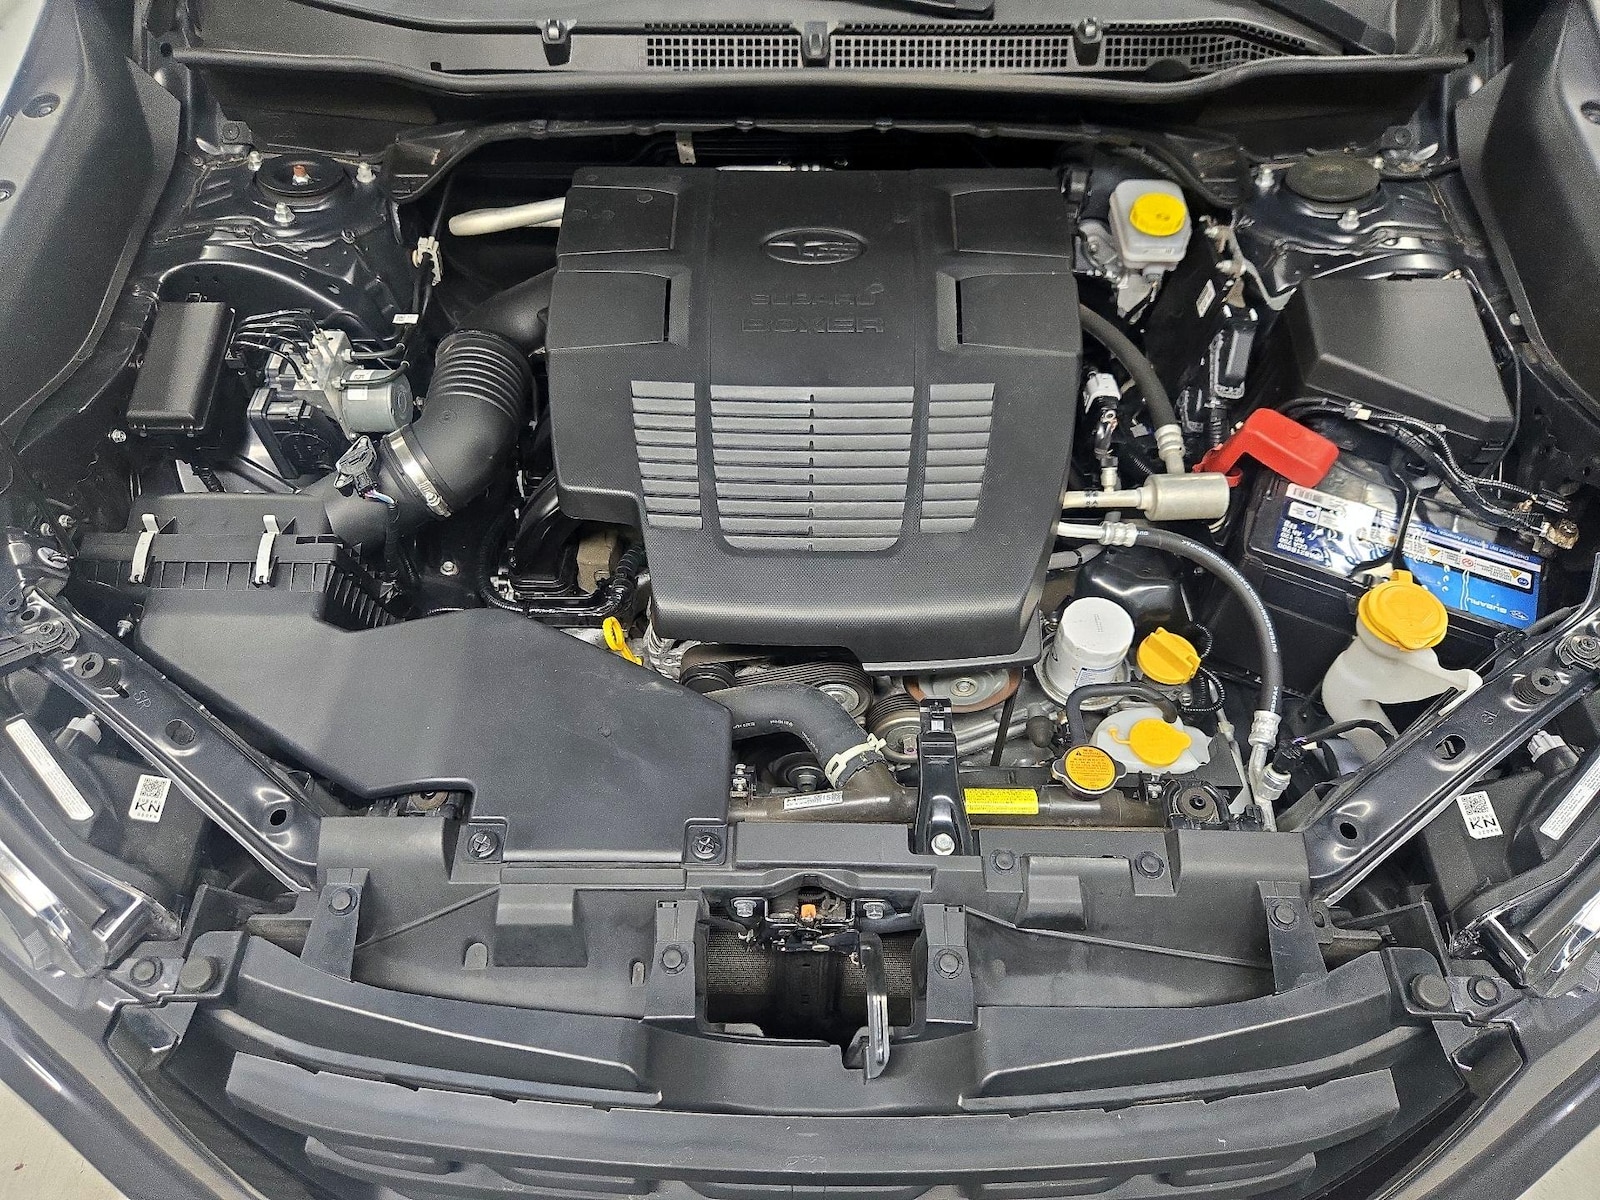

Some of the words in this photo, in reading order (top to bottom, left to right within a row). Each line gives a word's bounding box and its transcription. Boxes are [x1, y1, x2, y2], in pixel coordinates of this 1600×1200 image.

[741, 319, 884, 333] BOXER
[1467, 597, 1507, 614] SUBARU
[134, 690, 151, 709] SR
[135, 802, 160, 812] KN
[1470, 818, 1496, 829] KN
